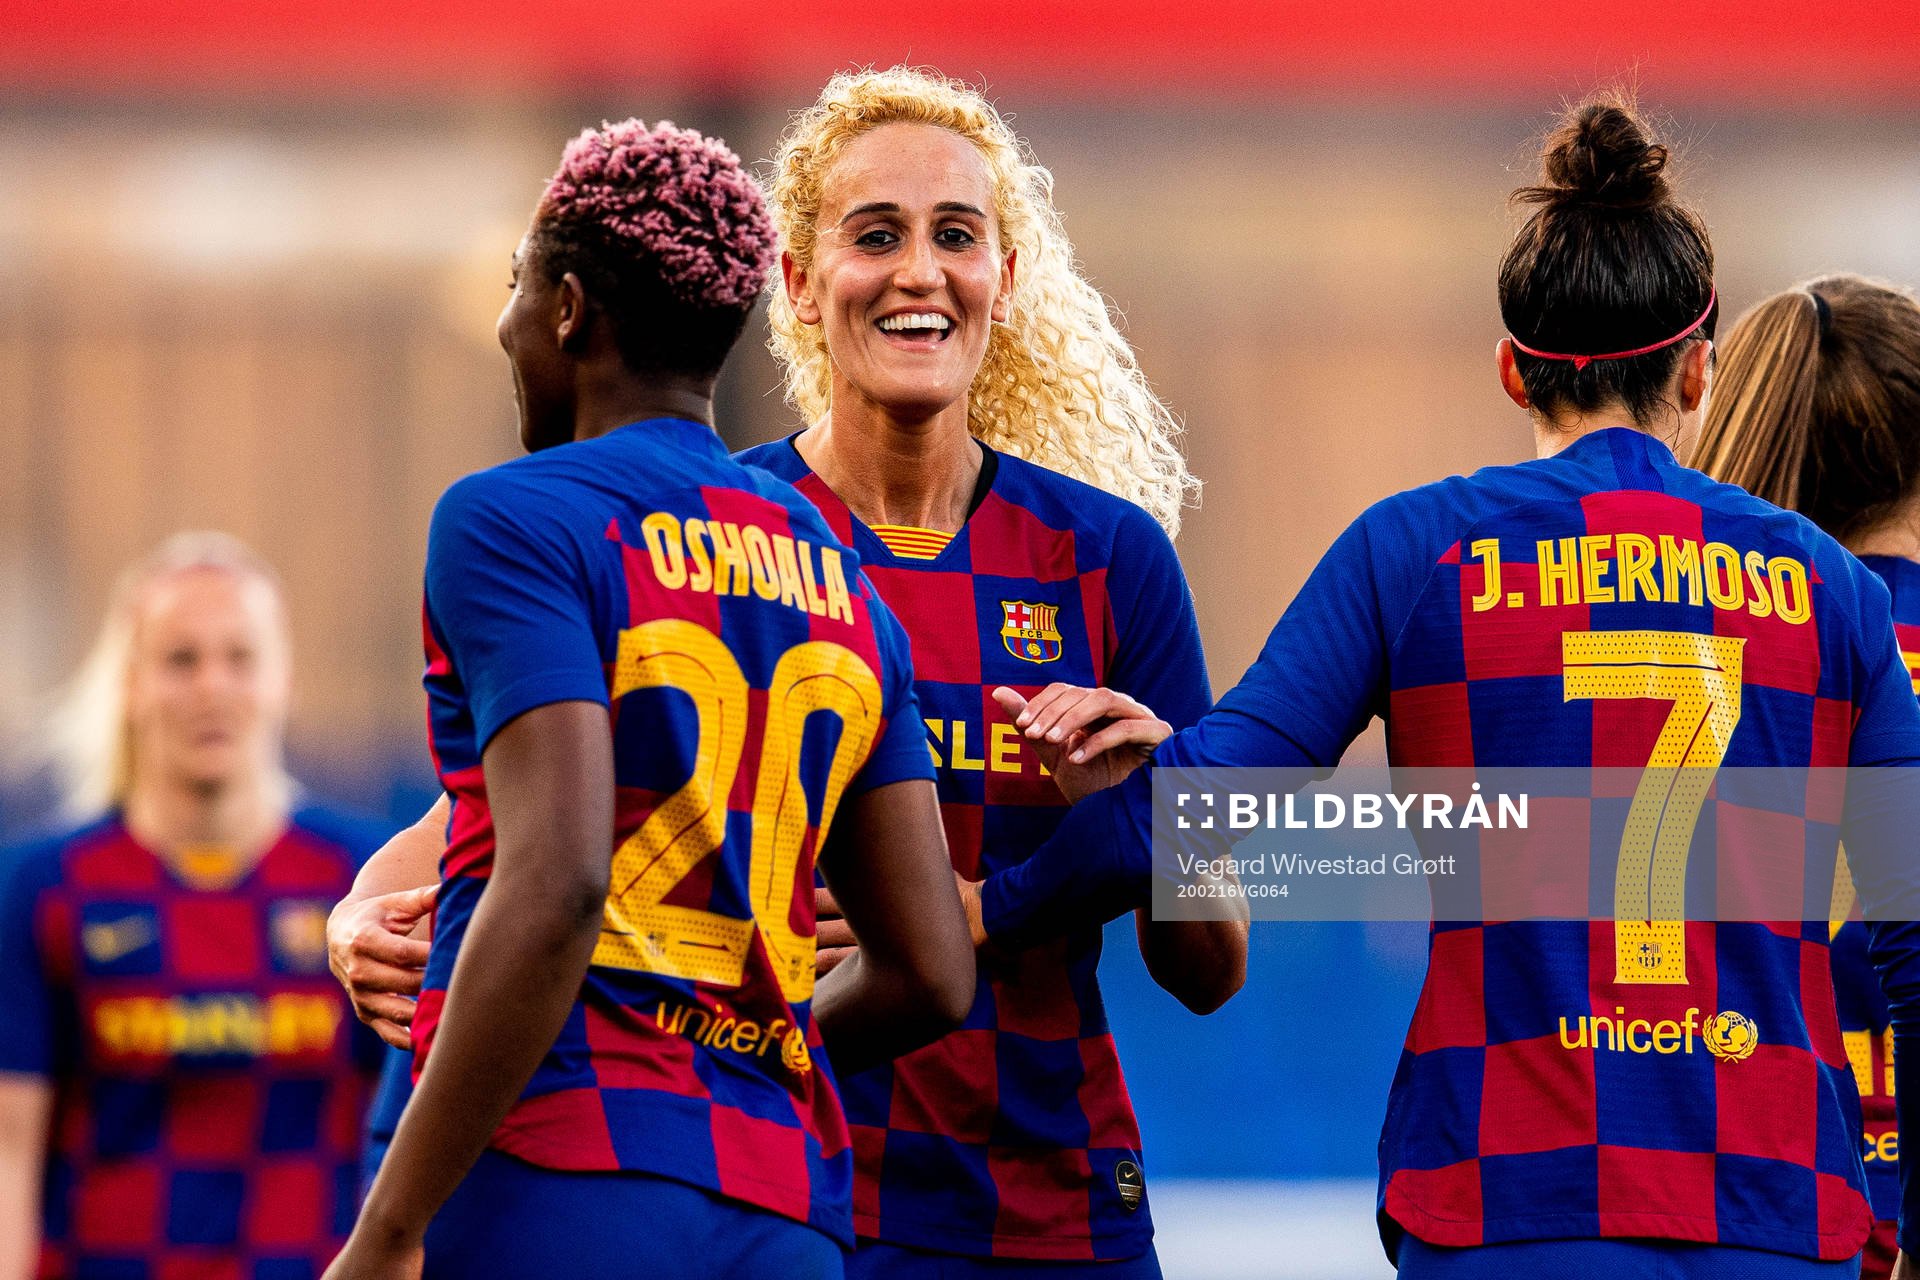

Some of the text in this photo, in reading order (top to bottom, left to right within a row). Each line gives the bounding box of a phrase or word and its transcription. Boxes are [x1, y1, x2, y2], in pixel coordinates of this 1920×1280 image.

[641, 512, 855, 626] OSHOALA
[1471, 533, 1812, 625] J. HERMOSO
[590, 618, 883, 1003] 20
[1562, 630, 1748, 985] 7
[656, 1001, 786, 1056] unicef
[1559, 1006, 1699, 1054] unicef
